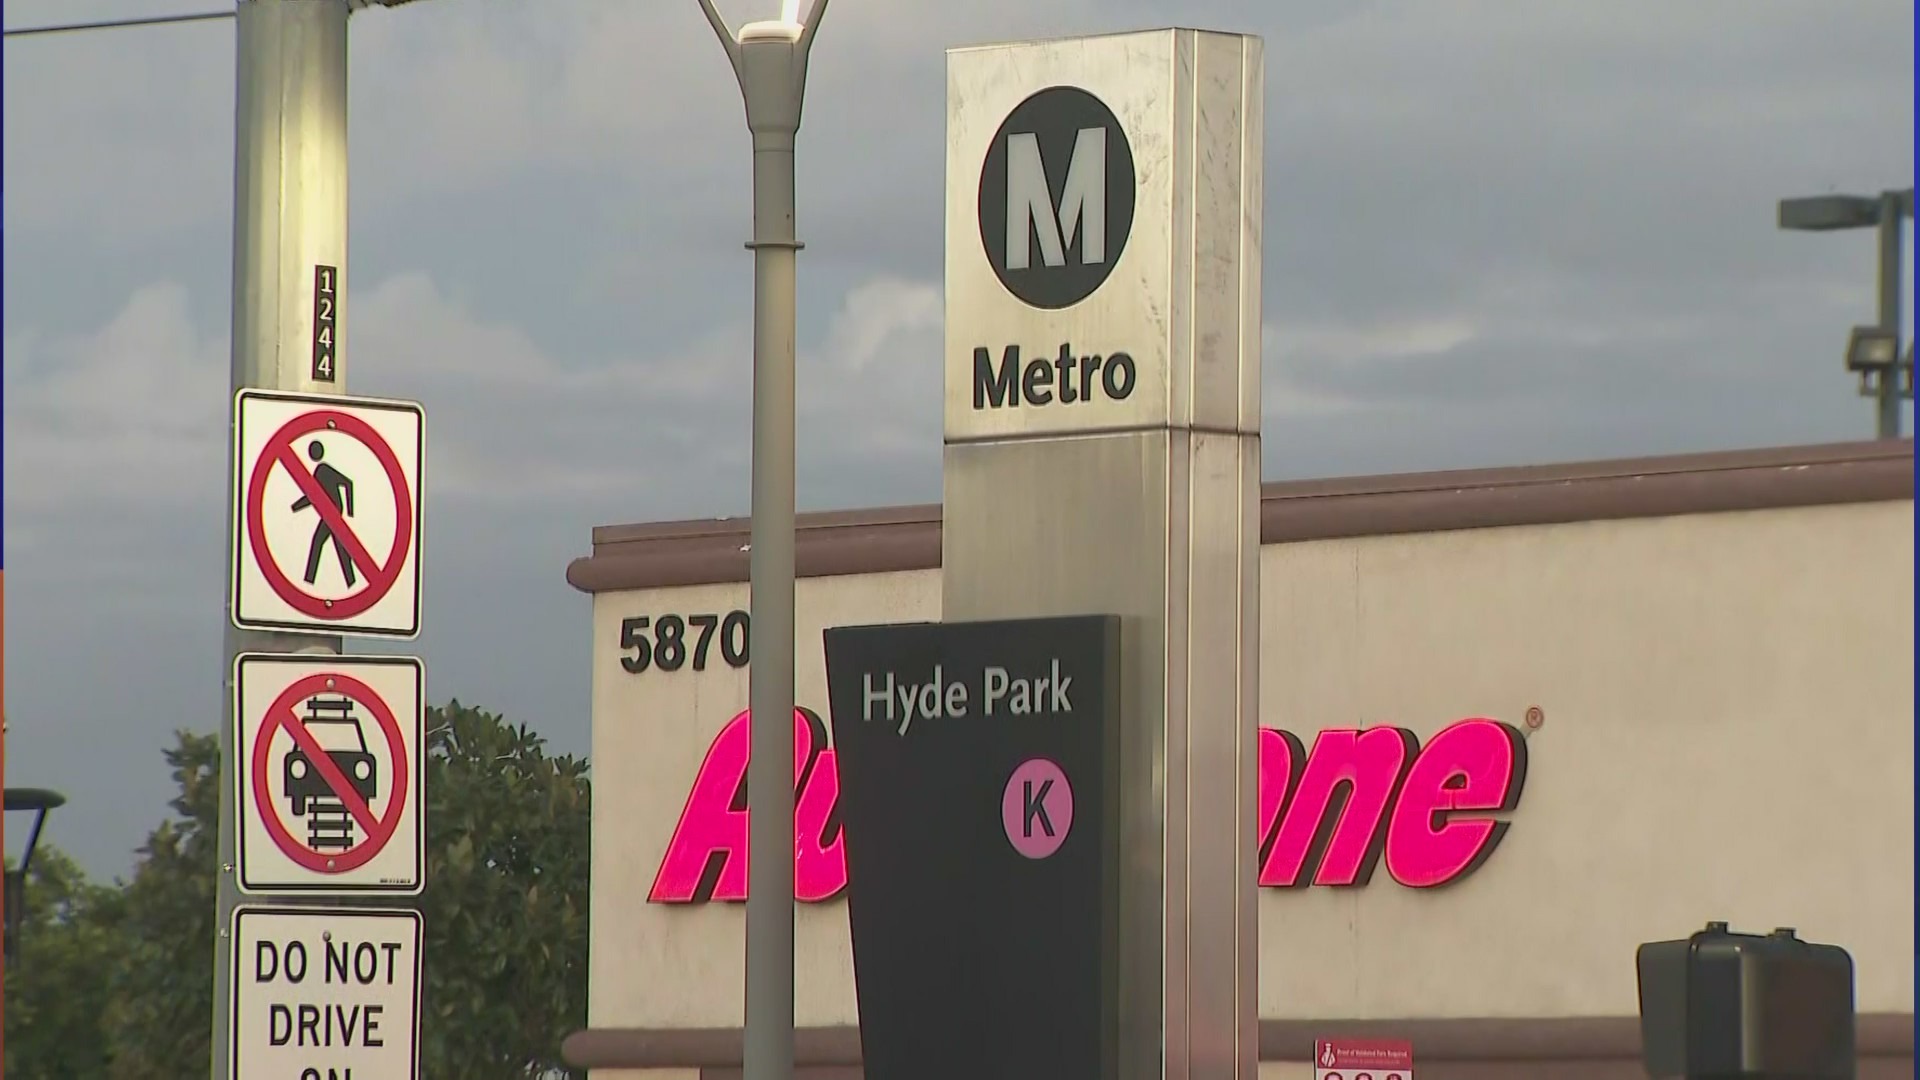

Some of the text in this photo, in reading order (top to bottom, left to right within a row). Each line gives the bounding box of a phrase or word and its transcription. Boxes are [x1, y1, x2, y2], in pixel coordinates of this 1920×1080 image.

[1006, 126, 1106, 269] M
[317, 269, 334, 376] 1244
[973, 342, 1136, 409] Metro
[619, 610, 750, 673] 5870
[862, 658, 1073, 735] Hyde Park
[1022, 779, 1056, 838] K
[255, 940, 402, 985] DO NOT
[269, 1003, 384, 1047] DRIVE
